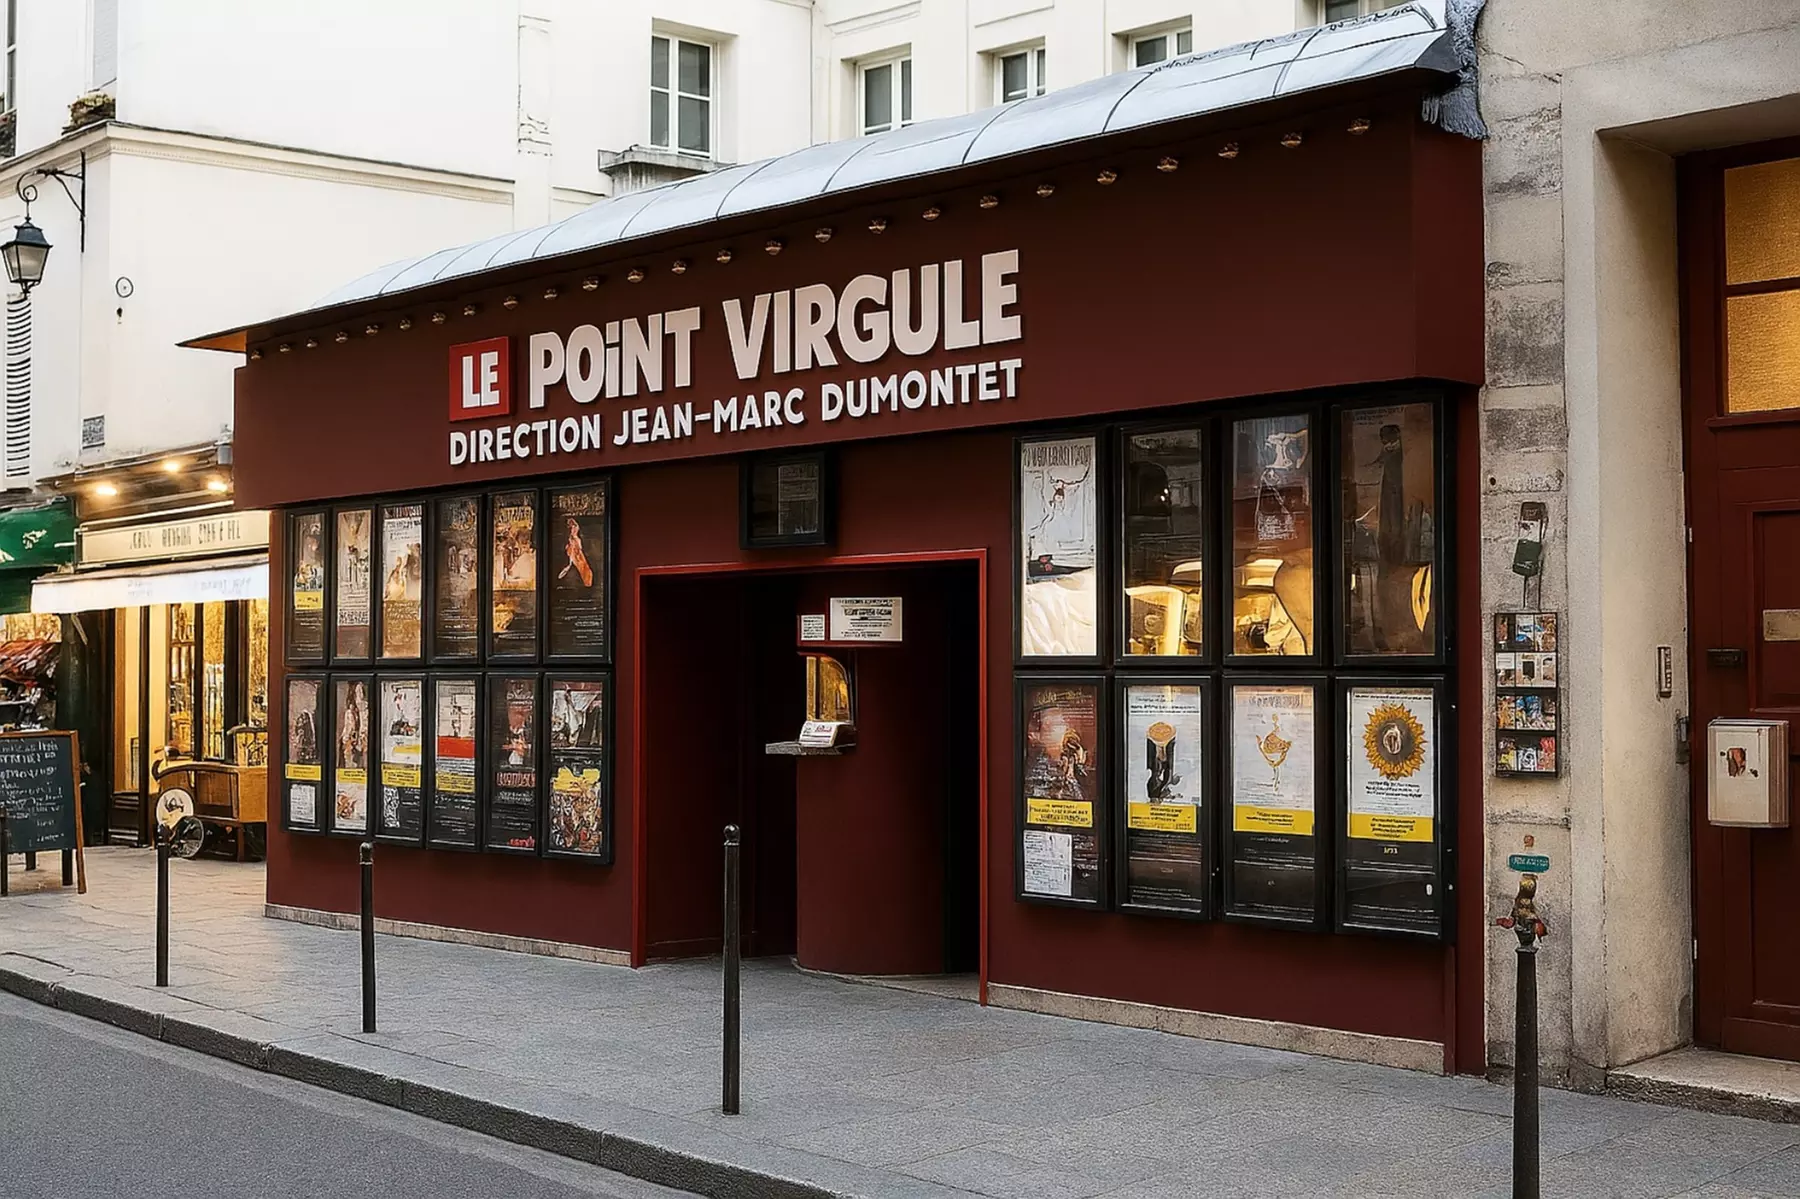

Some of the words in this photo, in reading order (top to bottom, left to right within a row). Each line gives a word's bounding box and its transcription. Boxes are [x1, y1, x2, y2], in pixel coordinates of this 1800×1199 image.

[462, 351, 500, 409] LE
[722, 249, 1022, 380] VIRGULE
[450, 413, 601, 465] DIRECTION
[613, 387, 805, 446] JEAN-MARC
[821, 358, 1022, 421] DUMONTET
